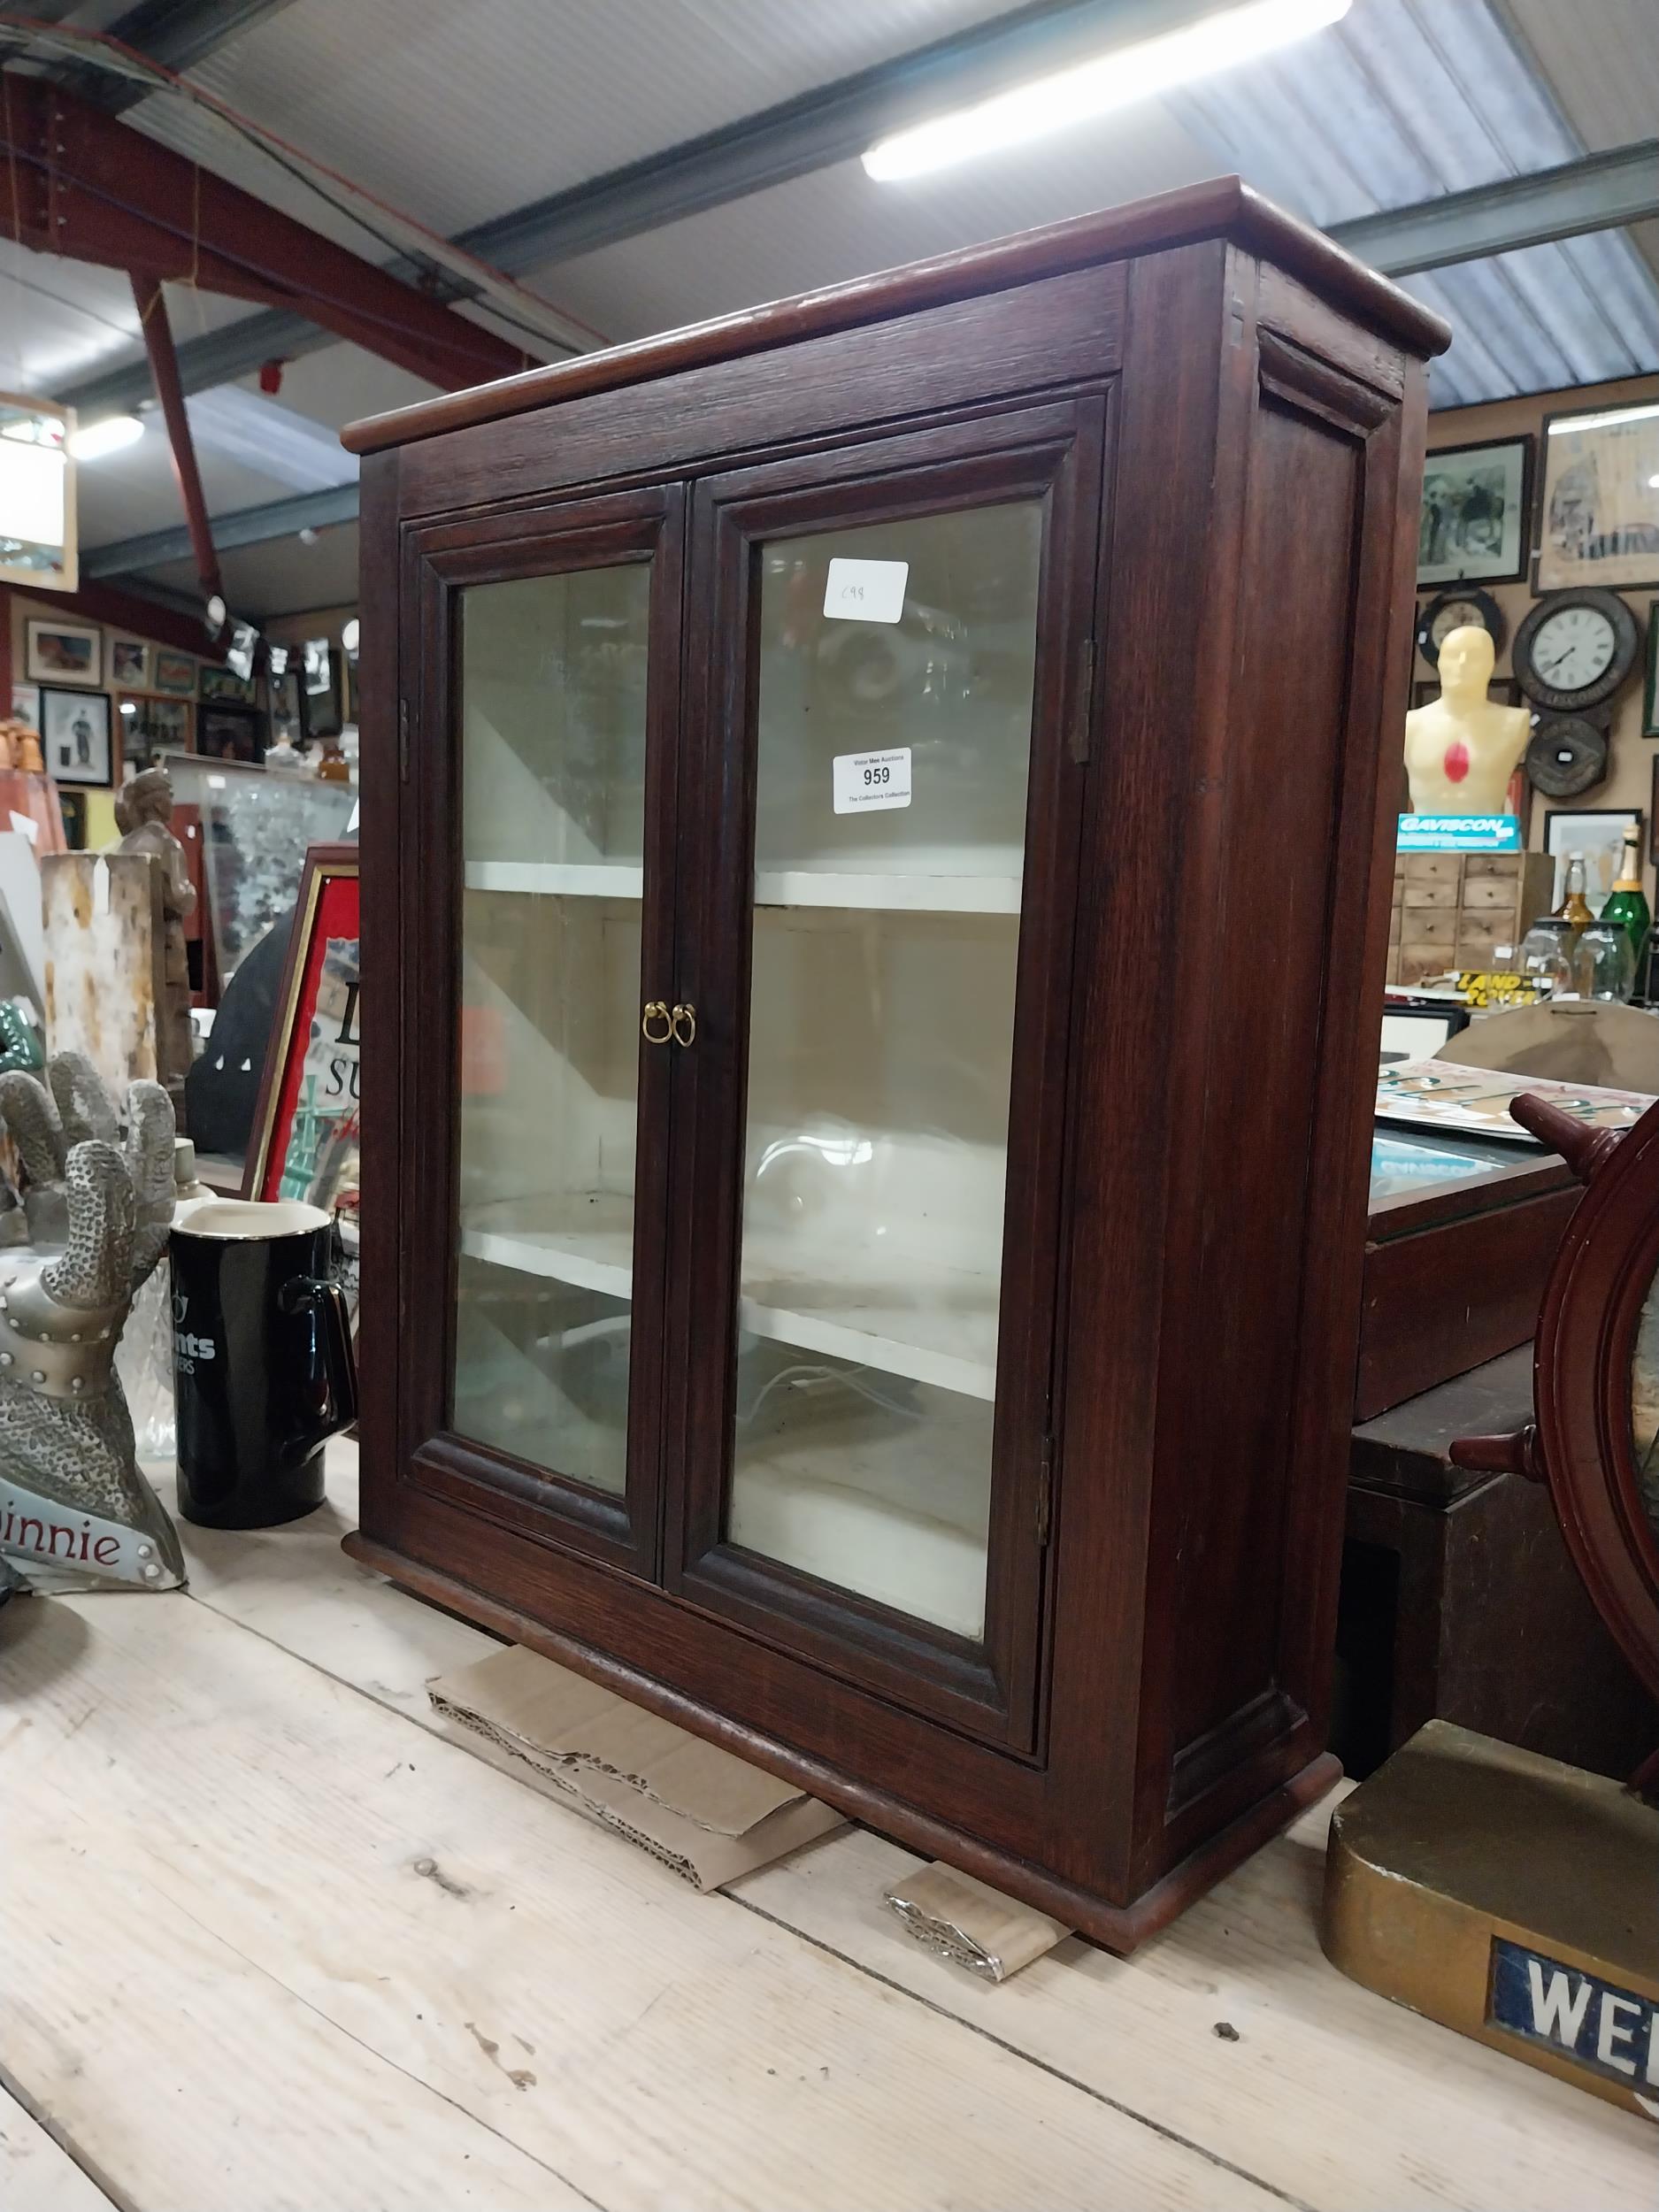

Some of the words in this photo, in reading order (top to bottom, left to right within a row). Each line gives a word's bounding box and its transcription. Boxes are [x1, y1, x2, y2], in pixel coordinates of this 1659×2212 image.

[864, 766, 890, 786] 959
[1400, 817, 1504, 832] GAVISCON
[0, 1500, 121, 1566] innie
